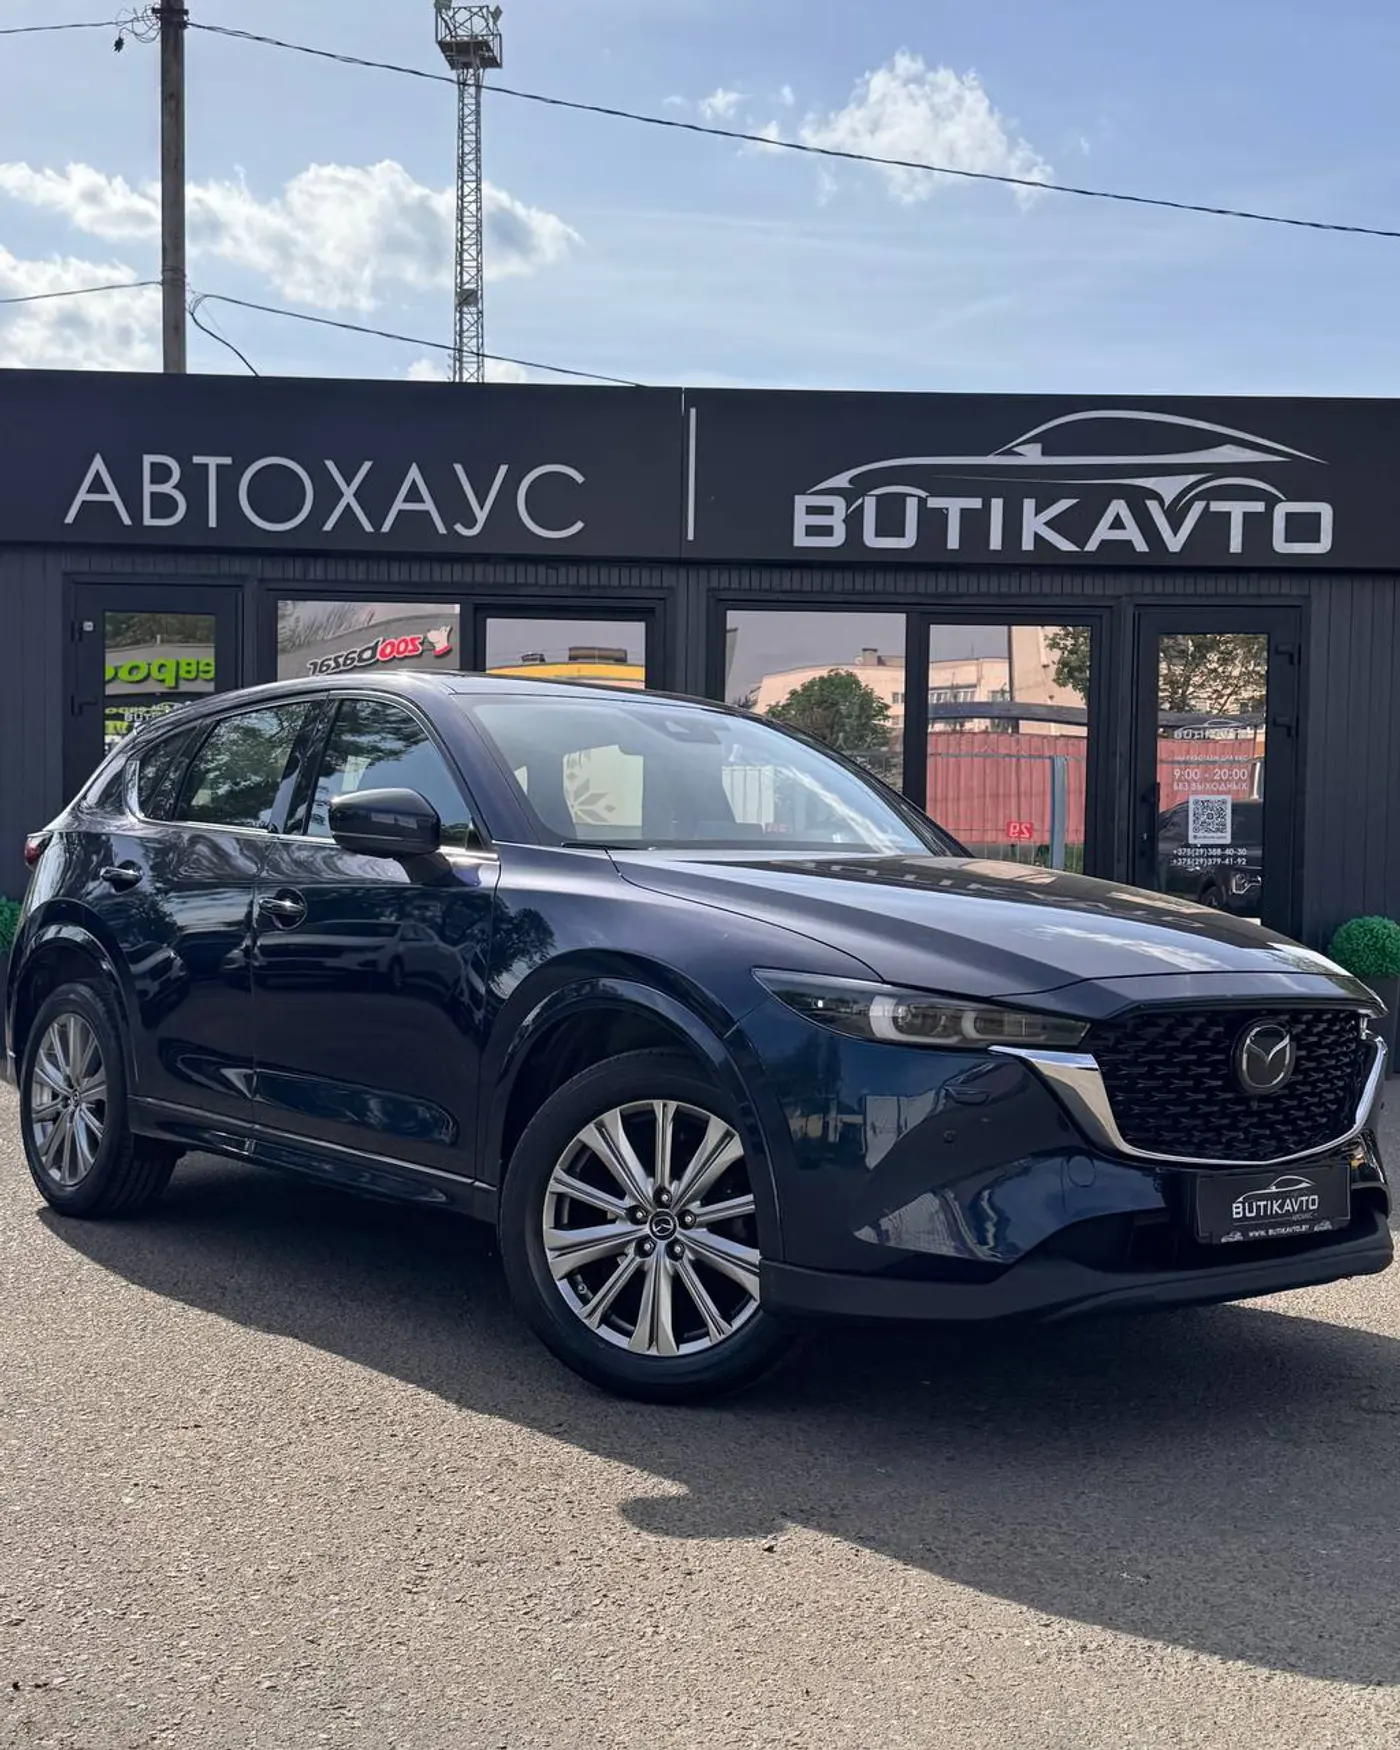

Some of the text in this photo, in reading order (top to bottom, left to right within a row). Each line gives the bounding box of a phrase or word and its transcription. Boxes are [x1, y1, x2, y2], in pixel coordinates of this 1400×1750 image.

[64, 452, 586, 539] АВТОХАУС
[793, 494, 1334, 554] BUTIKAVTO
[1173, 769, 1200, 780] 9:00
[1214, 769, 1248, 780] 20:00
[1232, 1195, 1319, 1219] BUTIKAVTO
